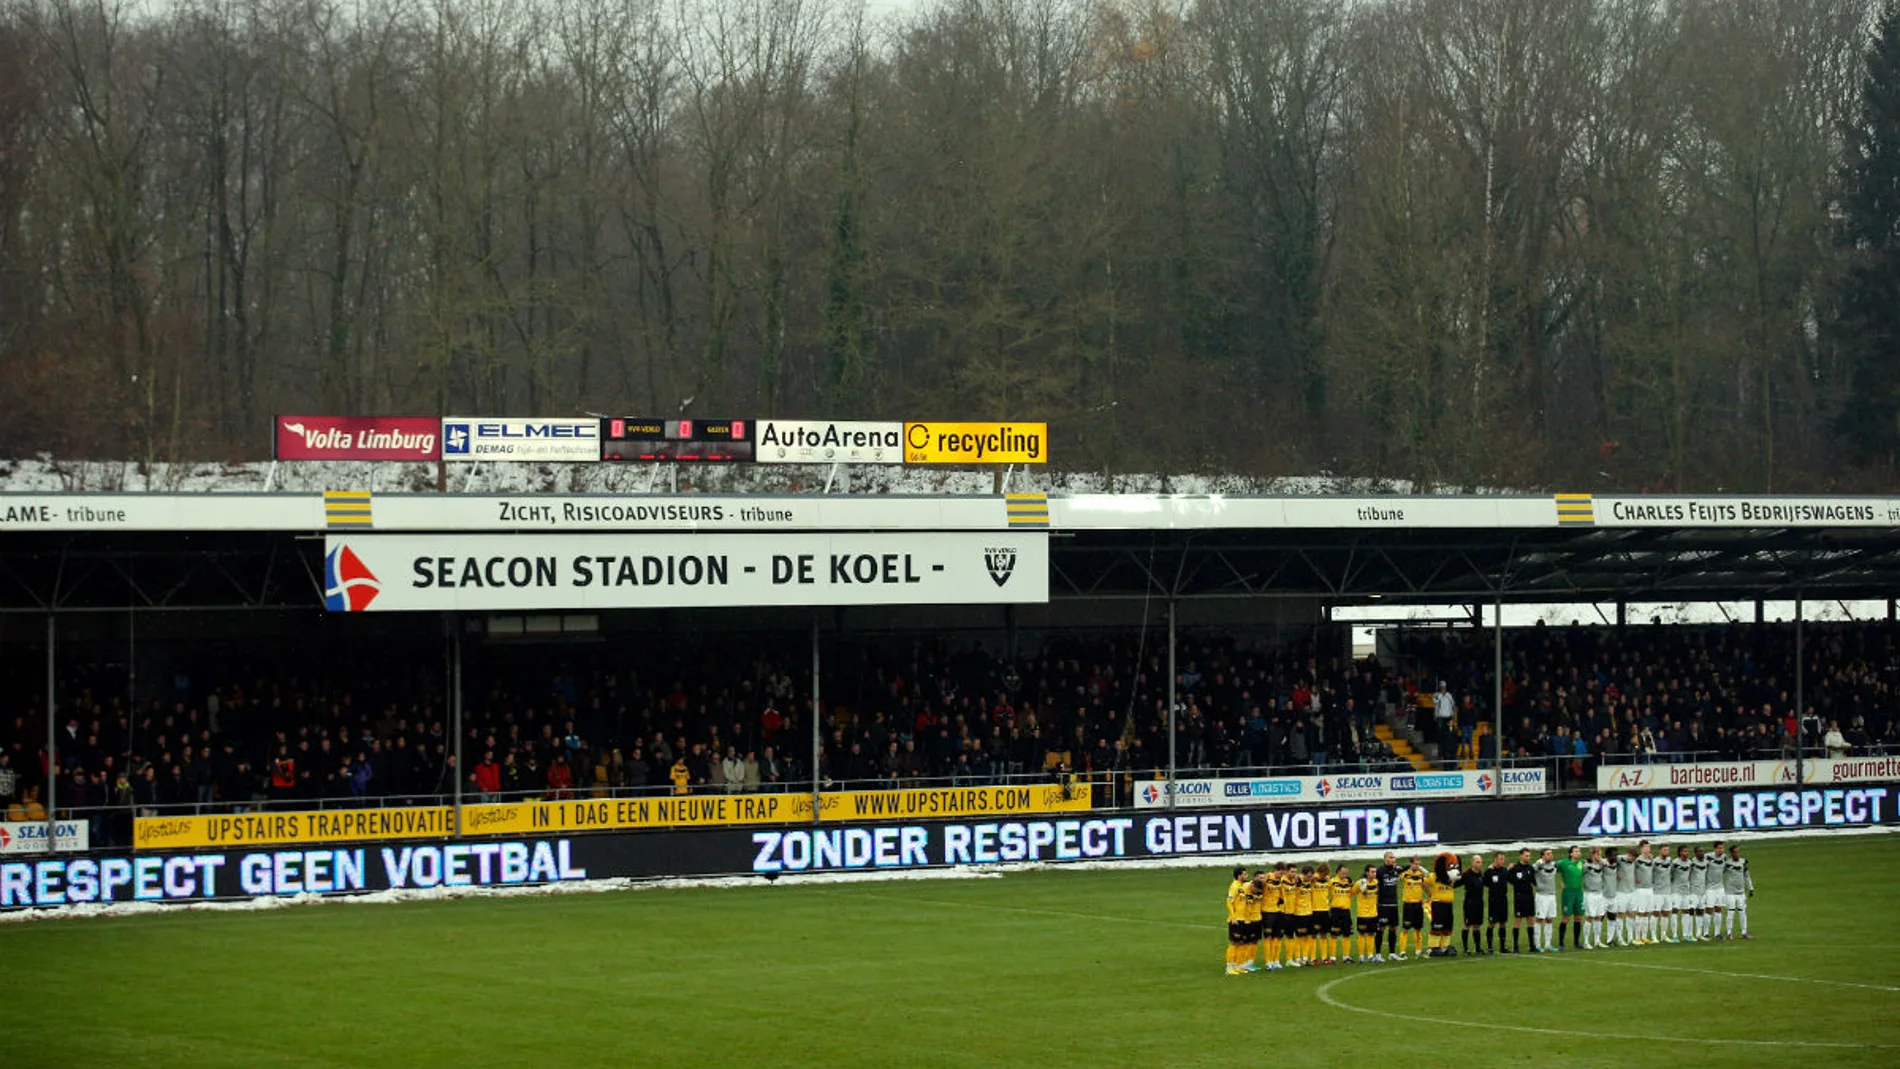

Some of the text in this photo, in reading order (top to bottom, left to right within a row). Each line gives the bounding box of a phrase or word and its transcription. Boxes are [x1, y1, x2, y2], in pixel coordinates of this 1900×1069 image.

[304, 428, 435, 454] Volta Limburg
[477, 423, 596, 438] ELMEC
[761, 423, 899, 447] AutoArena
[475, 444, 515, 454] DEMAG
[938, 426, 1040, 459] recycling
[0, 505, 127, 522] AME- tribune
[499, 502, 557, 524] ZICHT,
[563, 502, 724, 521] RISICOADVISEURS
[740, 507, 793, 521] tribune
[1357, 507, 1405, 521] tribune
[1613, 502, 1684, 521] CHARLES
[1689, 502, 1736, 522] FEIJTS
[1742, 502, 1874, 522] BEDRIJFSWAGENS
[412, 556, 557, 588] SEACON
[572, 555, 729, 588] STADION
[771, 554, 815, 584] DE
[830, 553, 921, 584] KOEL
[1336, 777, 1383, 789] SEACON
[1500, 771, 1542, 783] EACON
[1618, 769, 1644, 787] A-Z
[1670, 763, 1756, 785] barbecue.nl
[1225, 783, 1250, 795] BLUE
[532, 798, 779, 828] IN 1 DAG EEN NIEUWE TRAP
[854, 789, 1031, 815] WWW.UPSTAIRS.COM
[1576, 788, 1887, 836] ZONDER RESPECT
[207, 808, 456, 841] UPSTAIRS TRAPRENOVATIE
[752, 806, 1439, 873] ZONDER RESPECT GEEN VOETBAL
[0, 839, 587, 906] RESPECT GEEN VOETBAL
